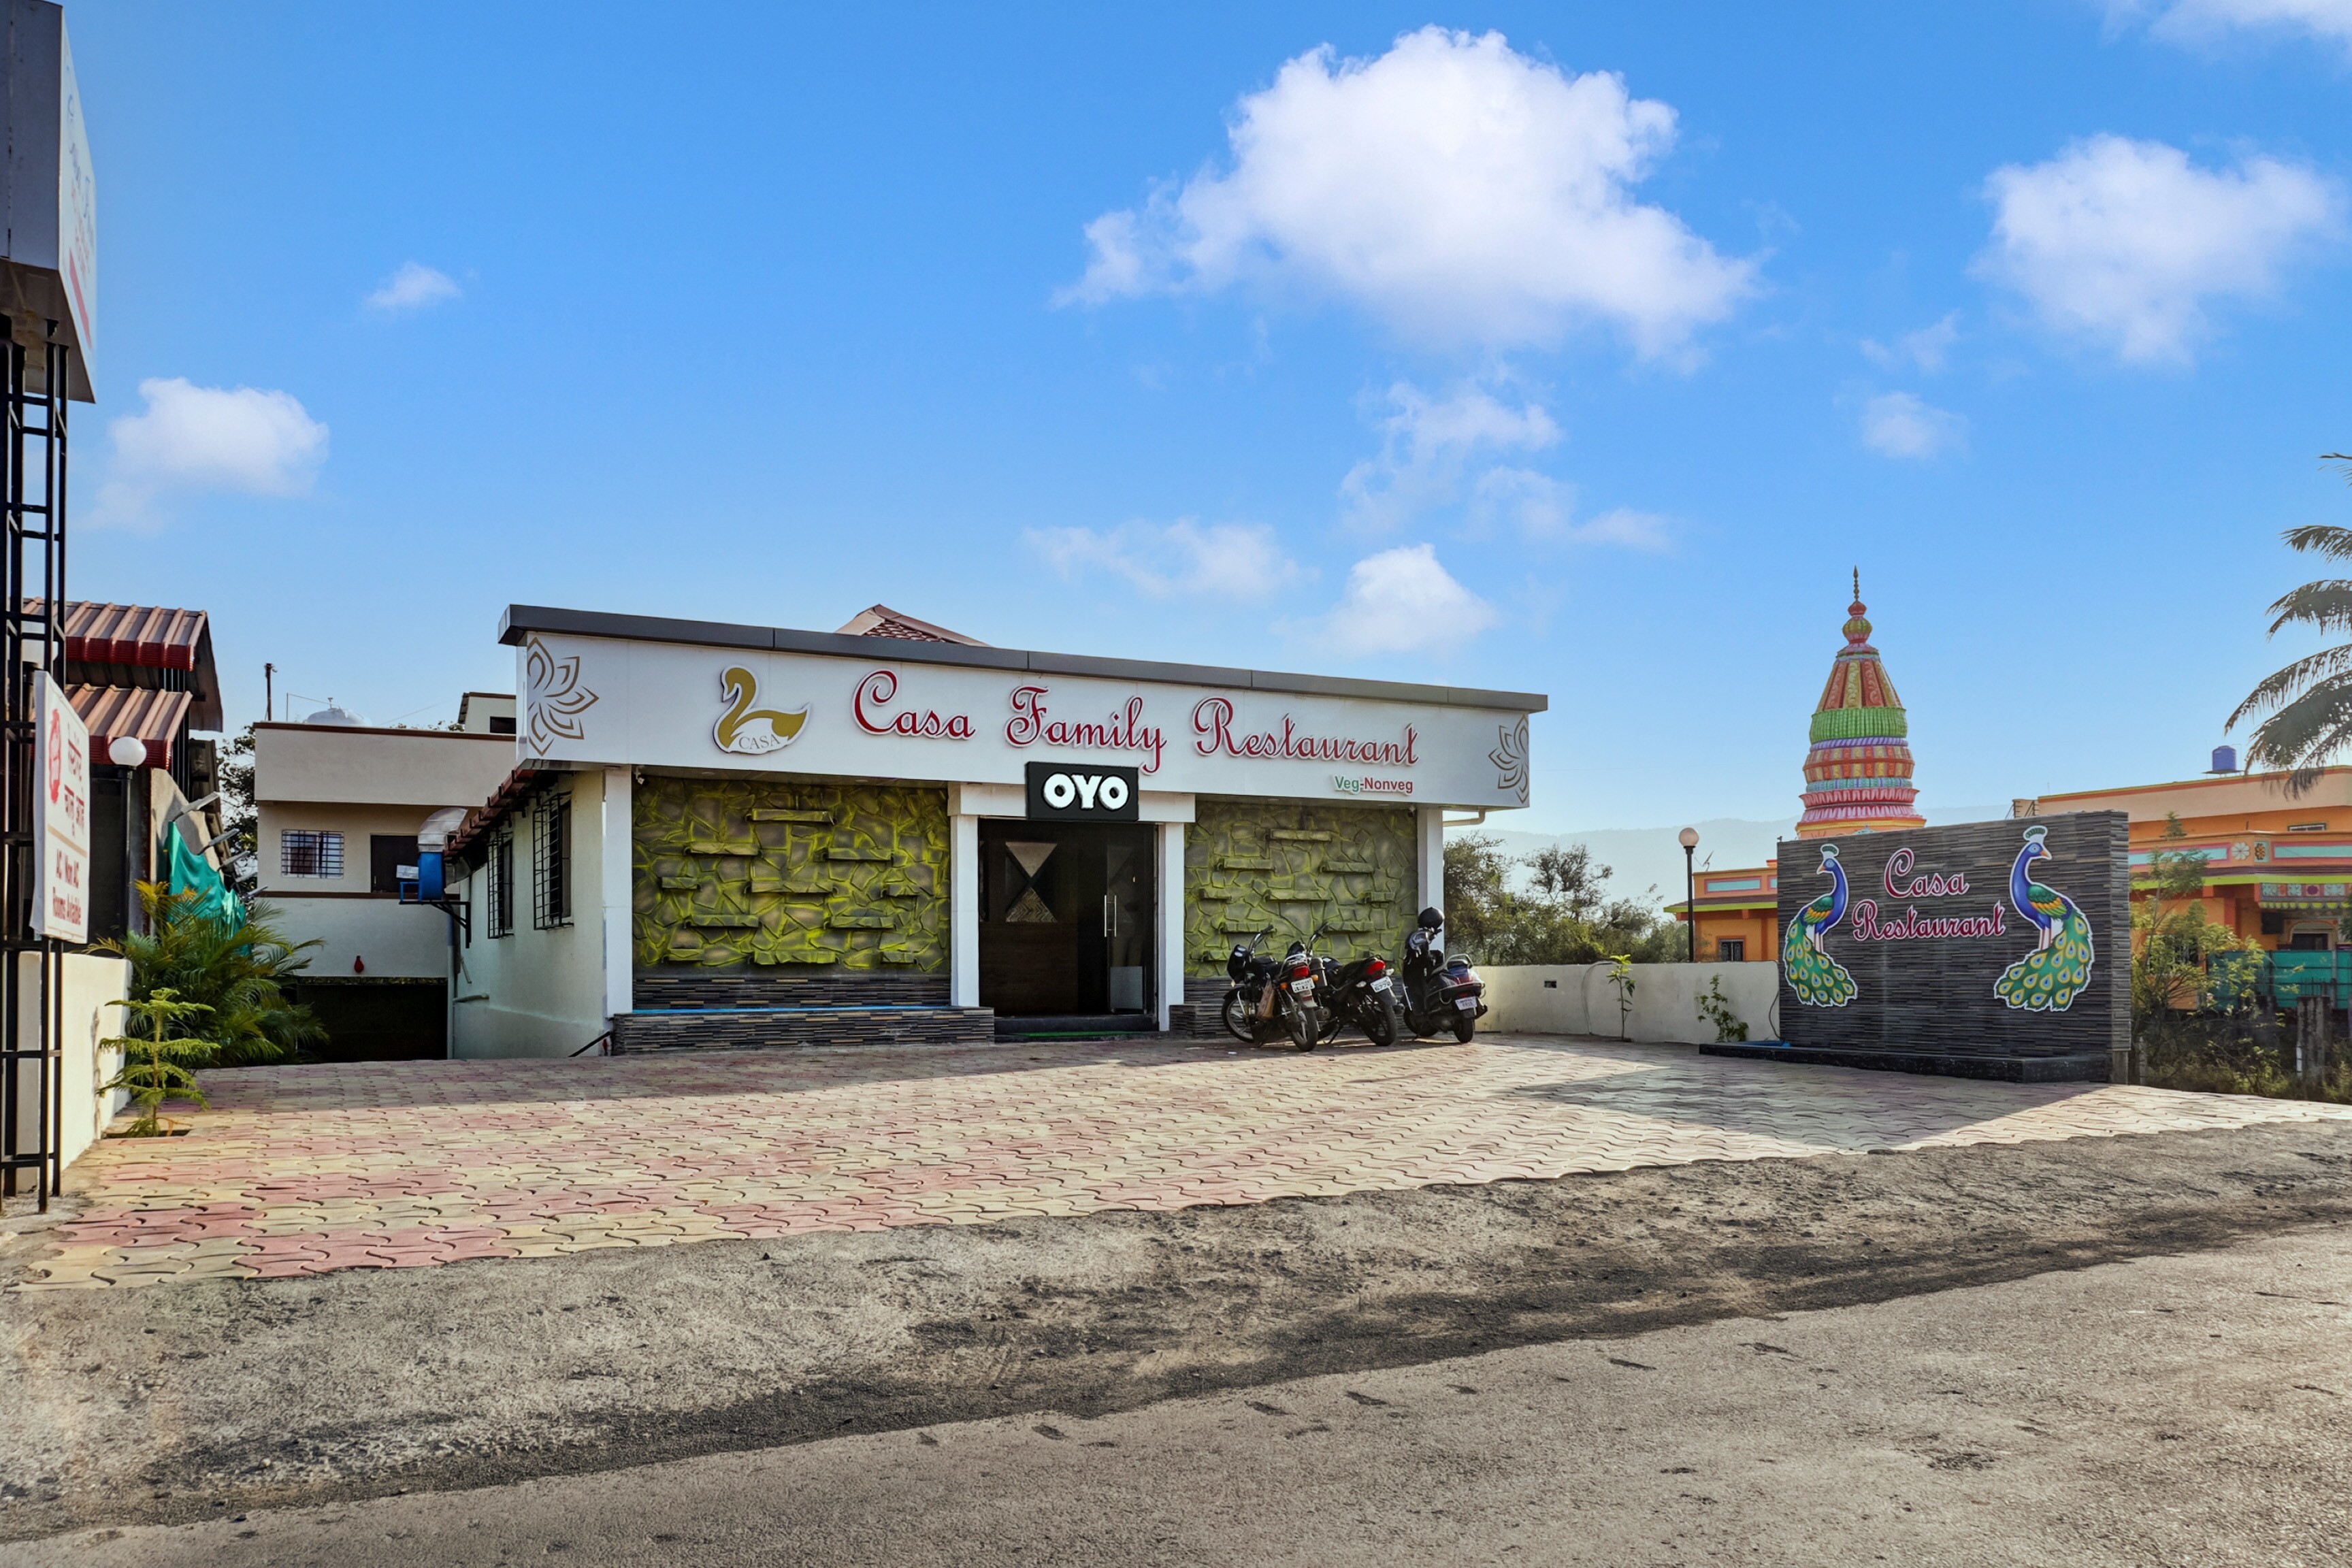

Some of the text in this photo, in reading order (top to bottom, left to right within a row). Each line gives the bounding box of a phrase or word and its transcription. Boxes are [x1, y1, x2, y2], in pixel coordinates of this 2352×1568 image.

[738, 734, 780, 749] CASA
[853, 670, 1418, 774] Casa Family Restaurant
[1042, 772, 1130, 811] OYO
[1335, 776, 1414, 794] Veg-Nonveg
[1884, 848, 1970, 898] Casa
[1852, 898, 2006, 942] Restaurant
